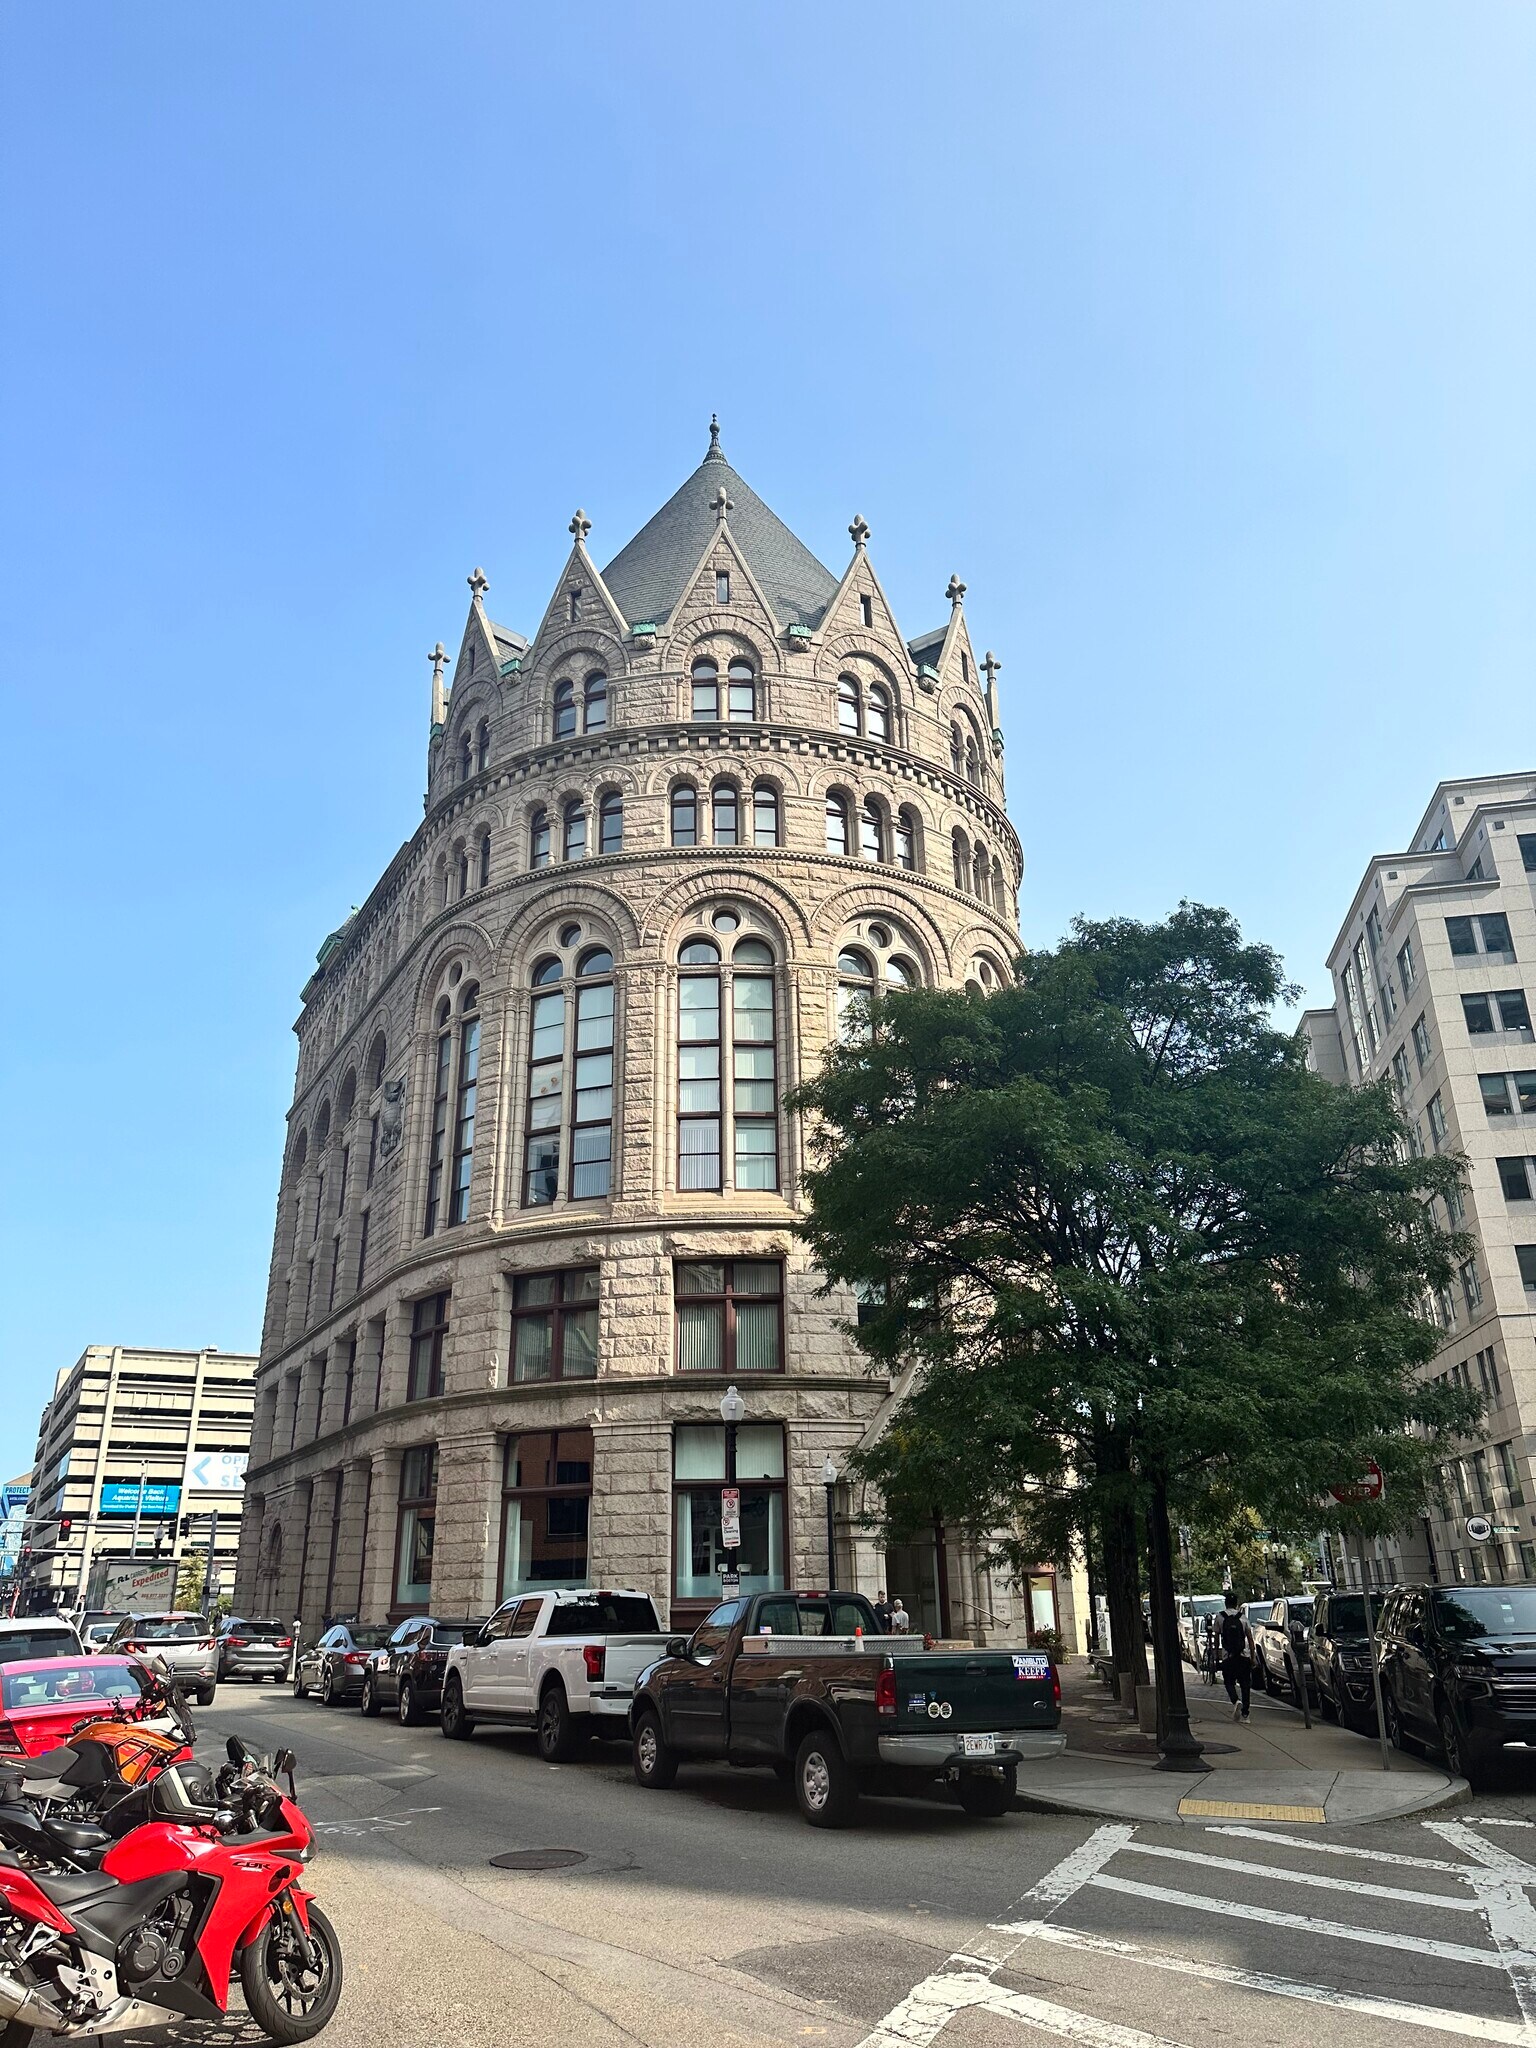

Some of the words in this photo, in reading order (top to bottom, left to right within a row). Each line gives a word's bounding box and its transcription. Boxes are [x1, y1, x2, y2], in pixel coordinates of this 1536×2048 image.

[5, 1486, 30, 1494] PROTECT
[118, 1487, 147, 1495] Welcoe
[131, 1567, 169, 1588] Expedited
[1012, 1656, 1047, 1666] ZAMBUTO
[1018, 1667, 1047, 1676] KEEFE
[965, 1739, 994, 1751] 2EWR76
